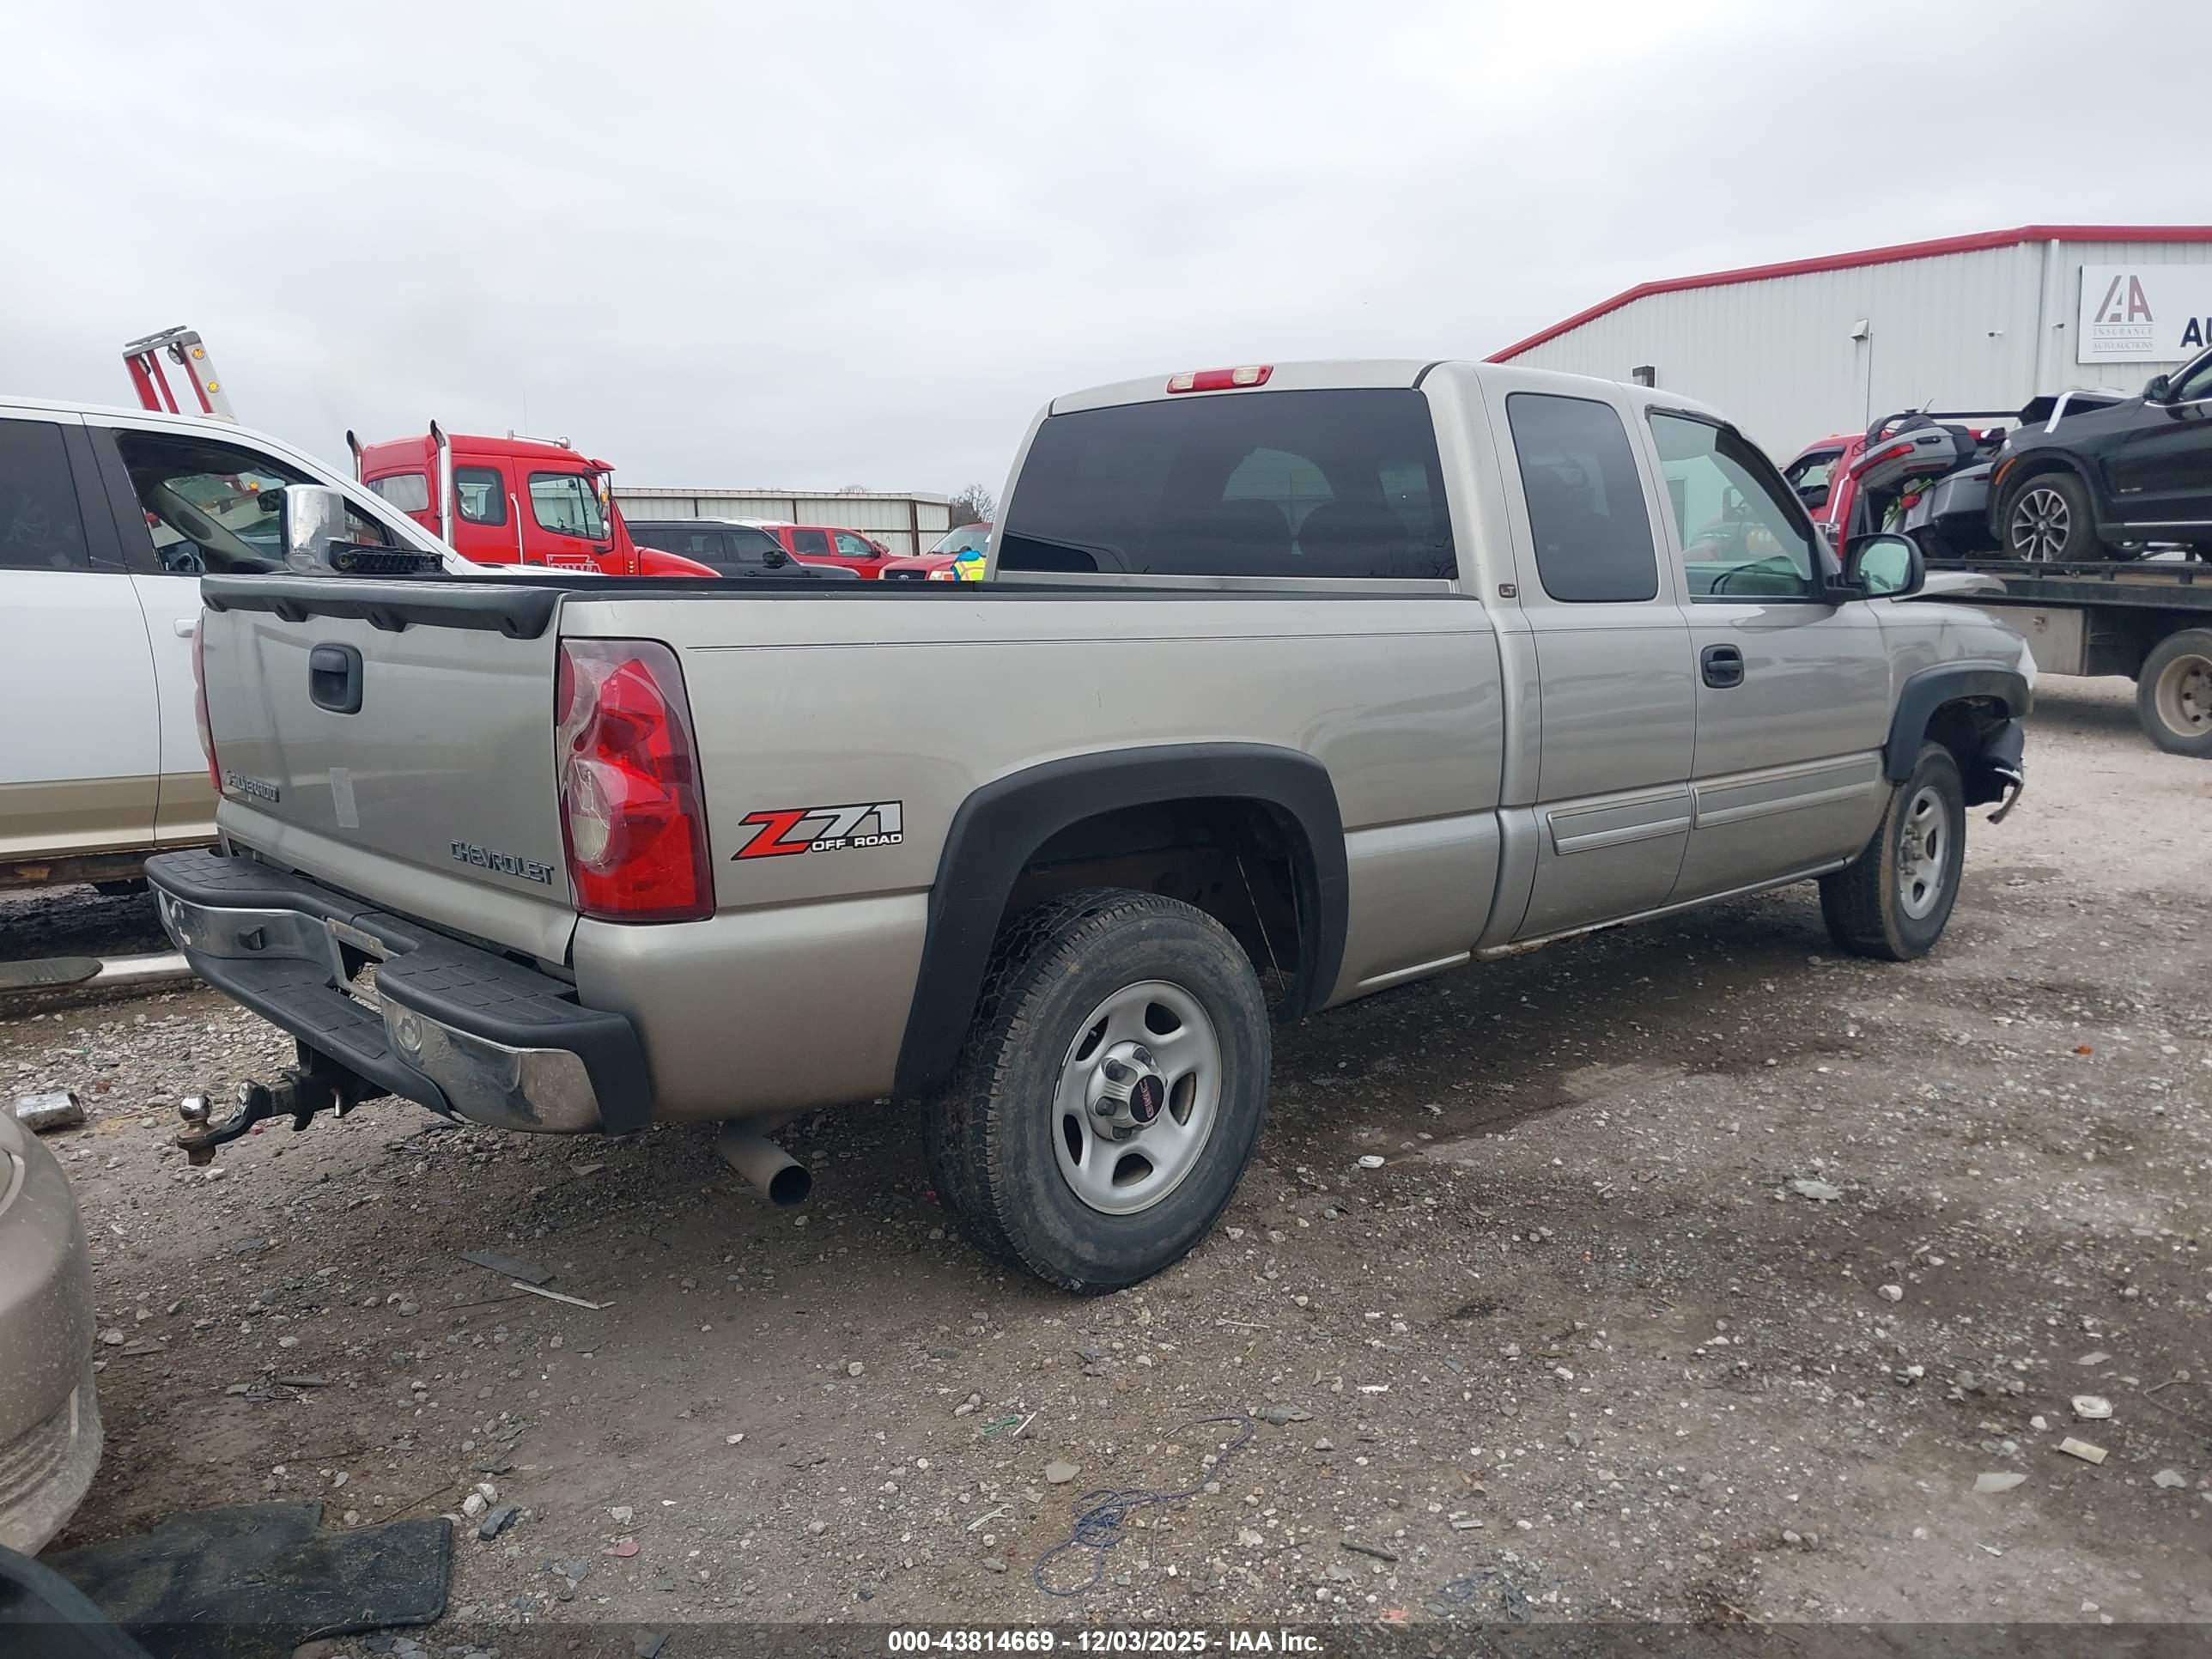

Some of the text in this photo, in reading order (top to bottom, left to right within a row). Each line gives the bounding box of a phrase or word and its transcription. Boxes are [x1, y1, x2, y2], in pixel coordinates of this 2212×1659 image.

[2094, 327, 2153, 336] INSURANCE
[2094, 342, 2114, 350] AUTO
[2179, 317, 2212, 348] A
[731, 800, 903, 860] Z71
[811, 833, 903, 852] OFF ROAD
[450, 839, 555, 885] CHEVROLET
[1139, 1079, 1154, 1118] GMC
